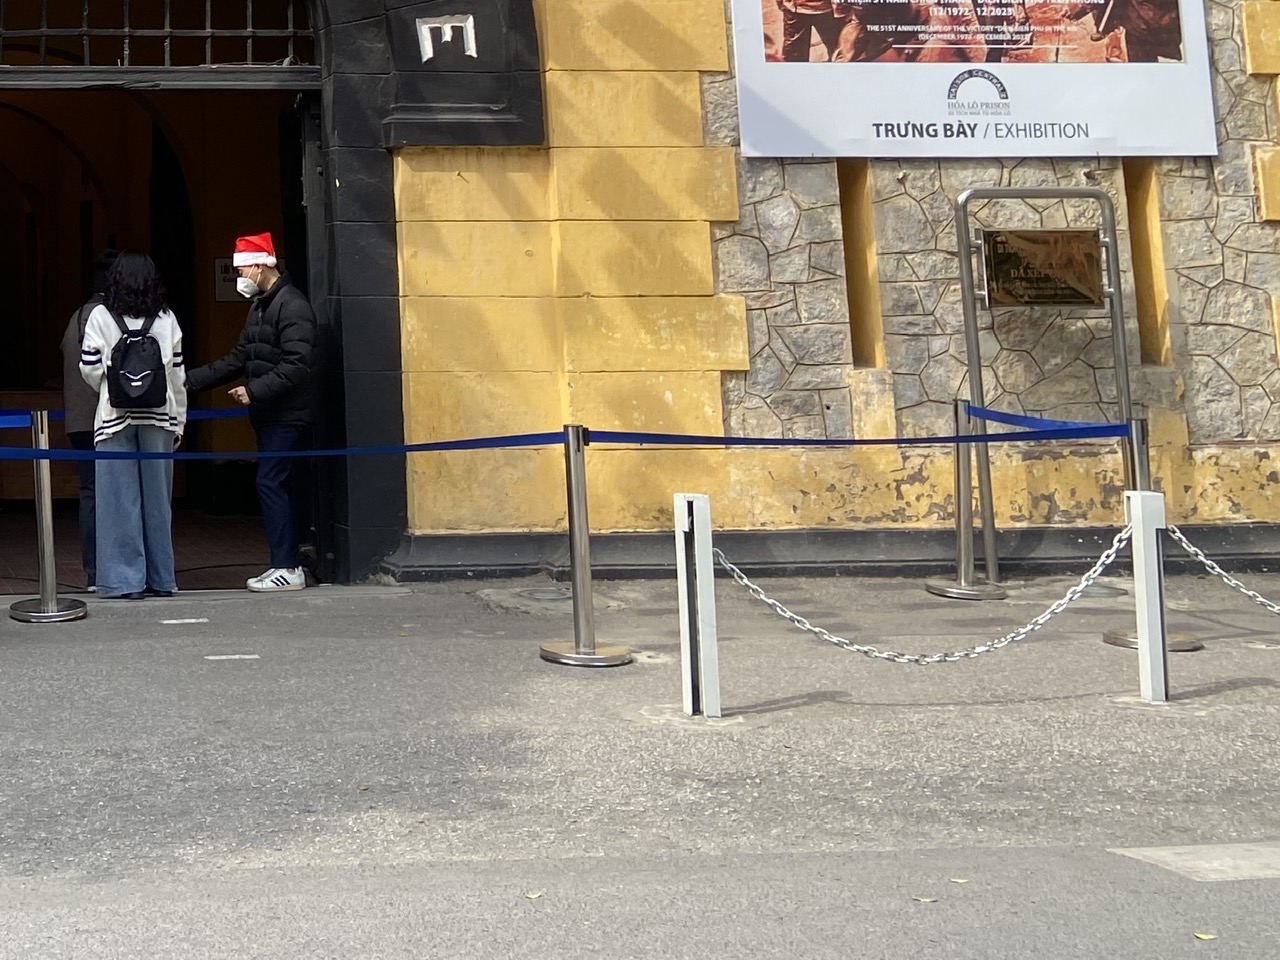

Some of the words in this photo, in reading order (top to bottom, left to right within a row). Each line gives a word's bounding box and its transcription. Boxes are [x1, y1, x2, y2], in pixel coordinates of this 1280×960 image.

[872, 121, 939, 139] TRƯNG
[943, 120, 978, 139] BÀY
[983, 123, 990, 139] /
[995, 122, 1090, 139] EXHIBITION
